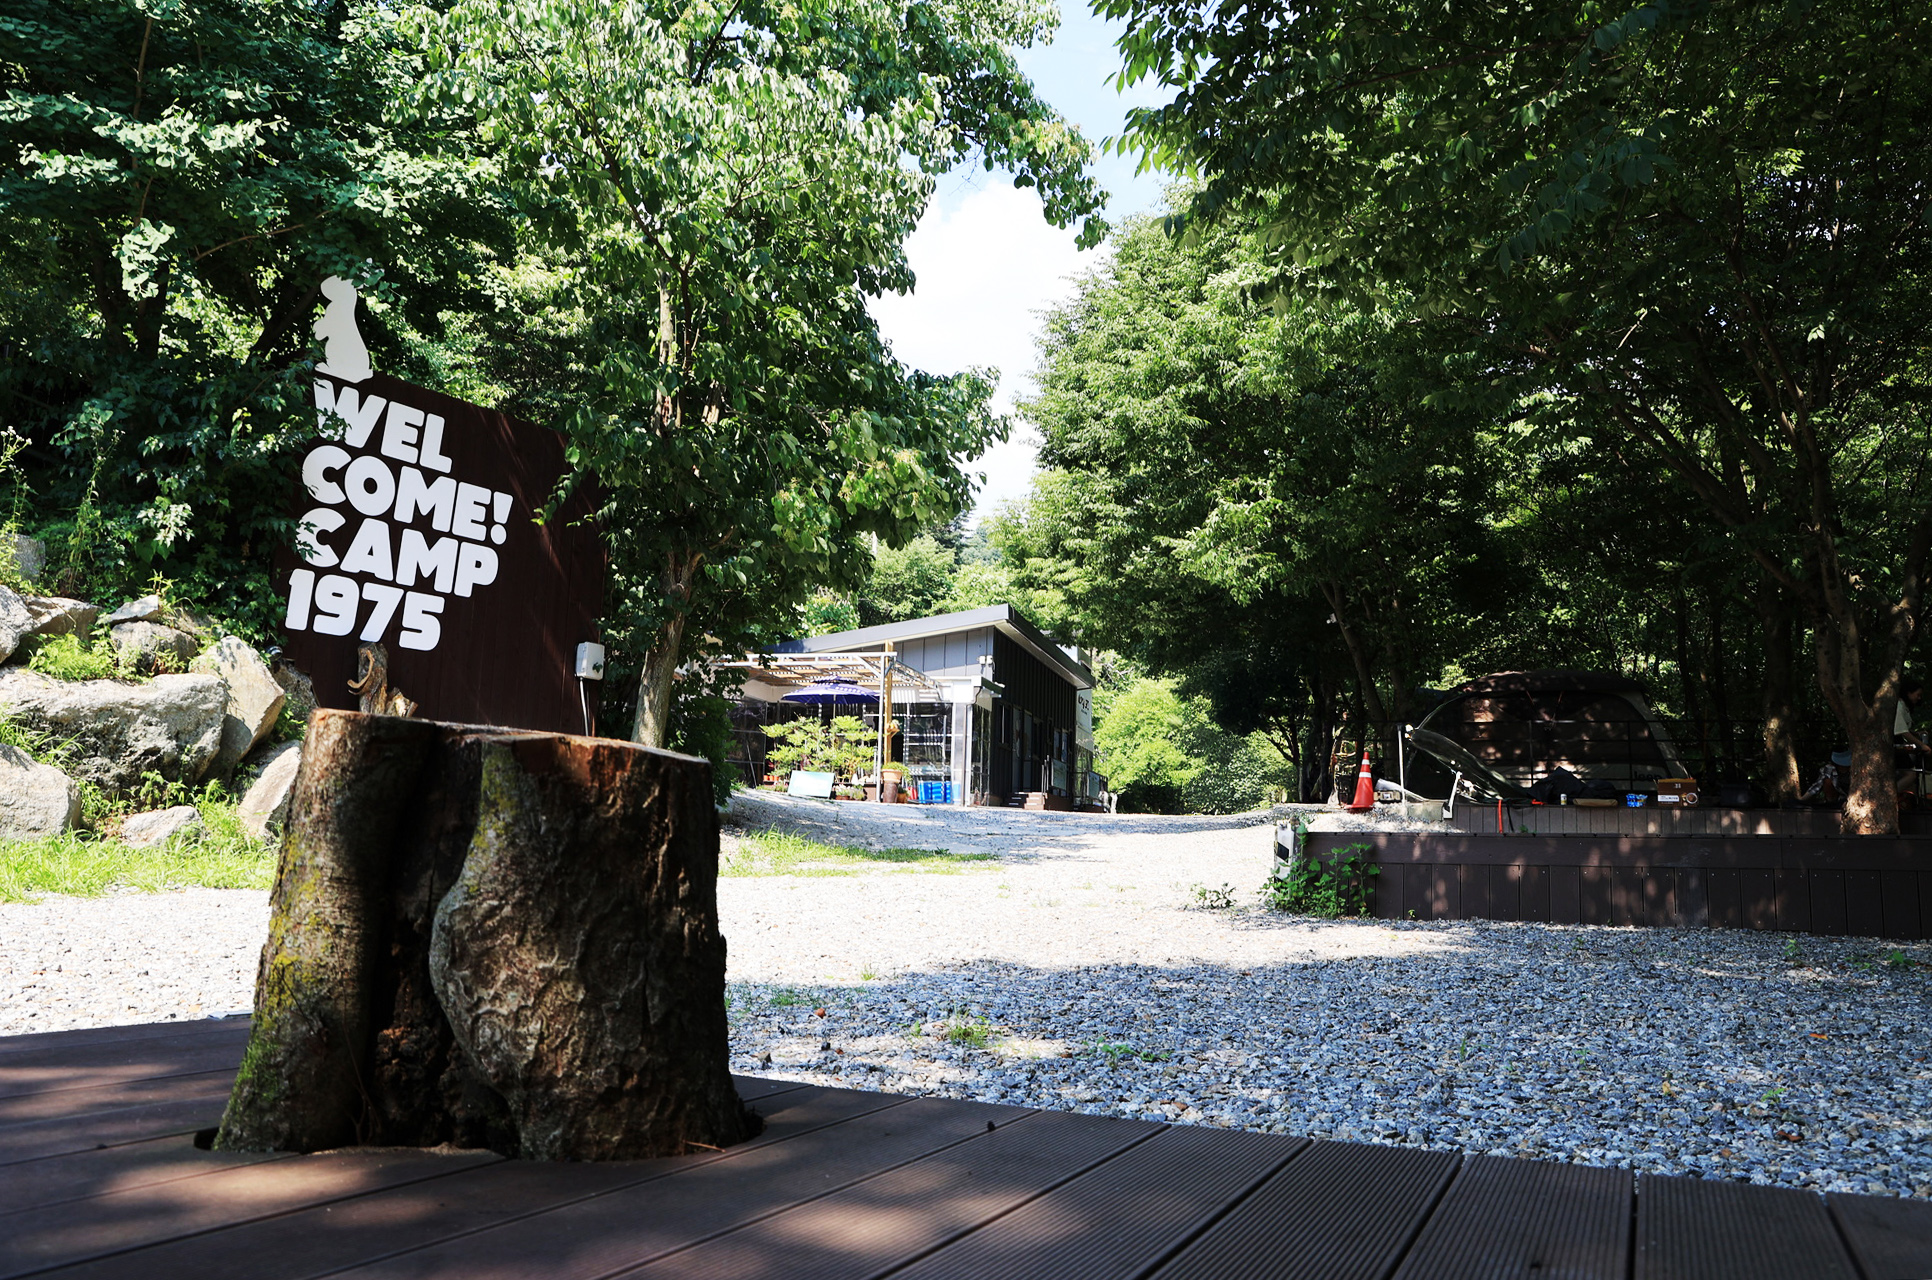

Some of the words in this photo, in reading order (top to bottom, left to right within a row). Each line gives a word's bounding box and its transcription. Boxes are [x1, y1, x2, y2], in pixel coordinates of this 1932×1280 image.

[313, 378, 453, 474] WEL
[302, 446, 514, 545] COME!
[295, 507, 499, 598] CAMP
[285, 568, 445, 651] 1975
